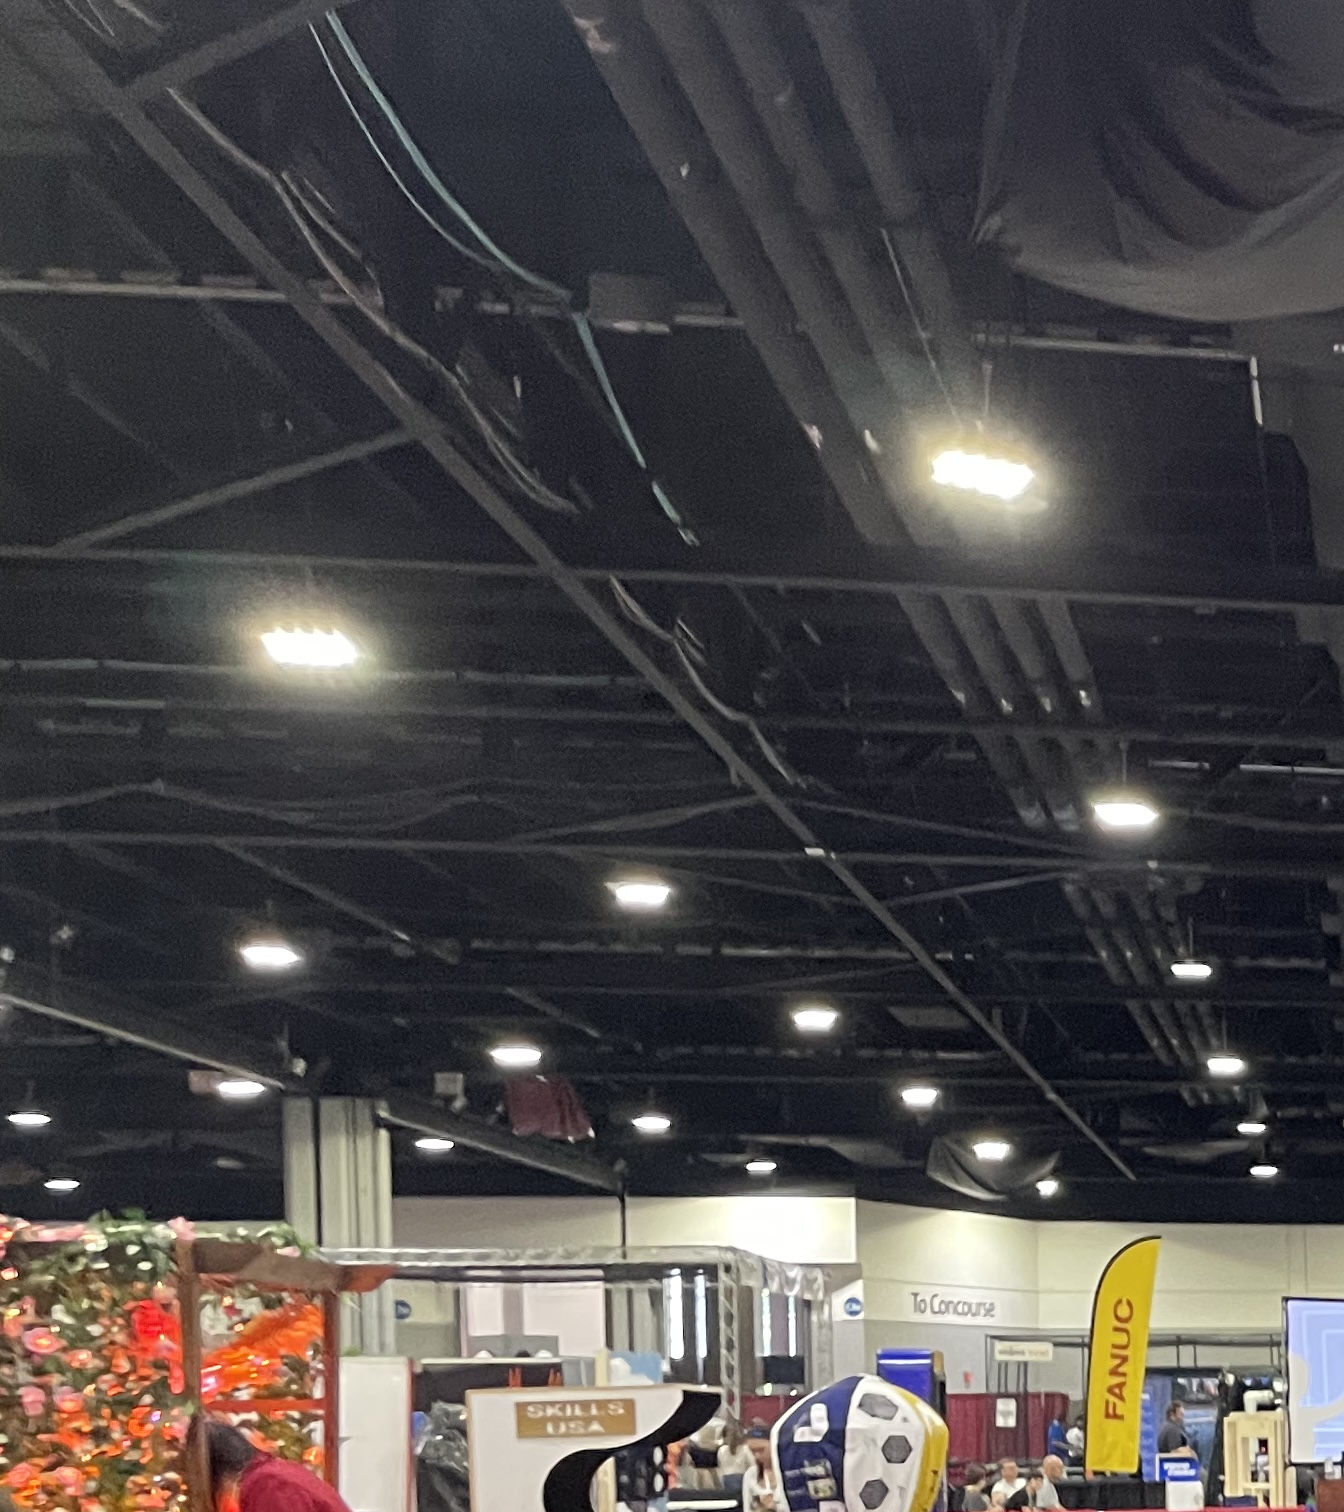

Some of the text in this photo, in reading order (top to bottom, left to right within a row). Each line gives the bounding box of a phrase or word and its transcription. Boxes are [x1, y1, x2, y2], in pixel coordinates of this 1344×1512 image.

[911, 1292, 996, 1318] To Concourse
[1104, 1298, 1135, 1422] FANUC
[526, 1401, 626, 1419] SKILLS
[546, 1420, 606, 1436] USA
